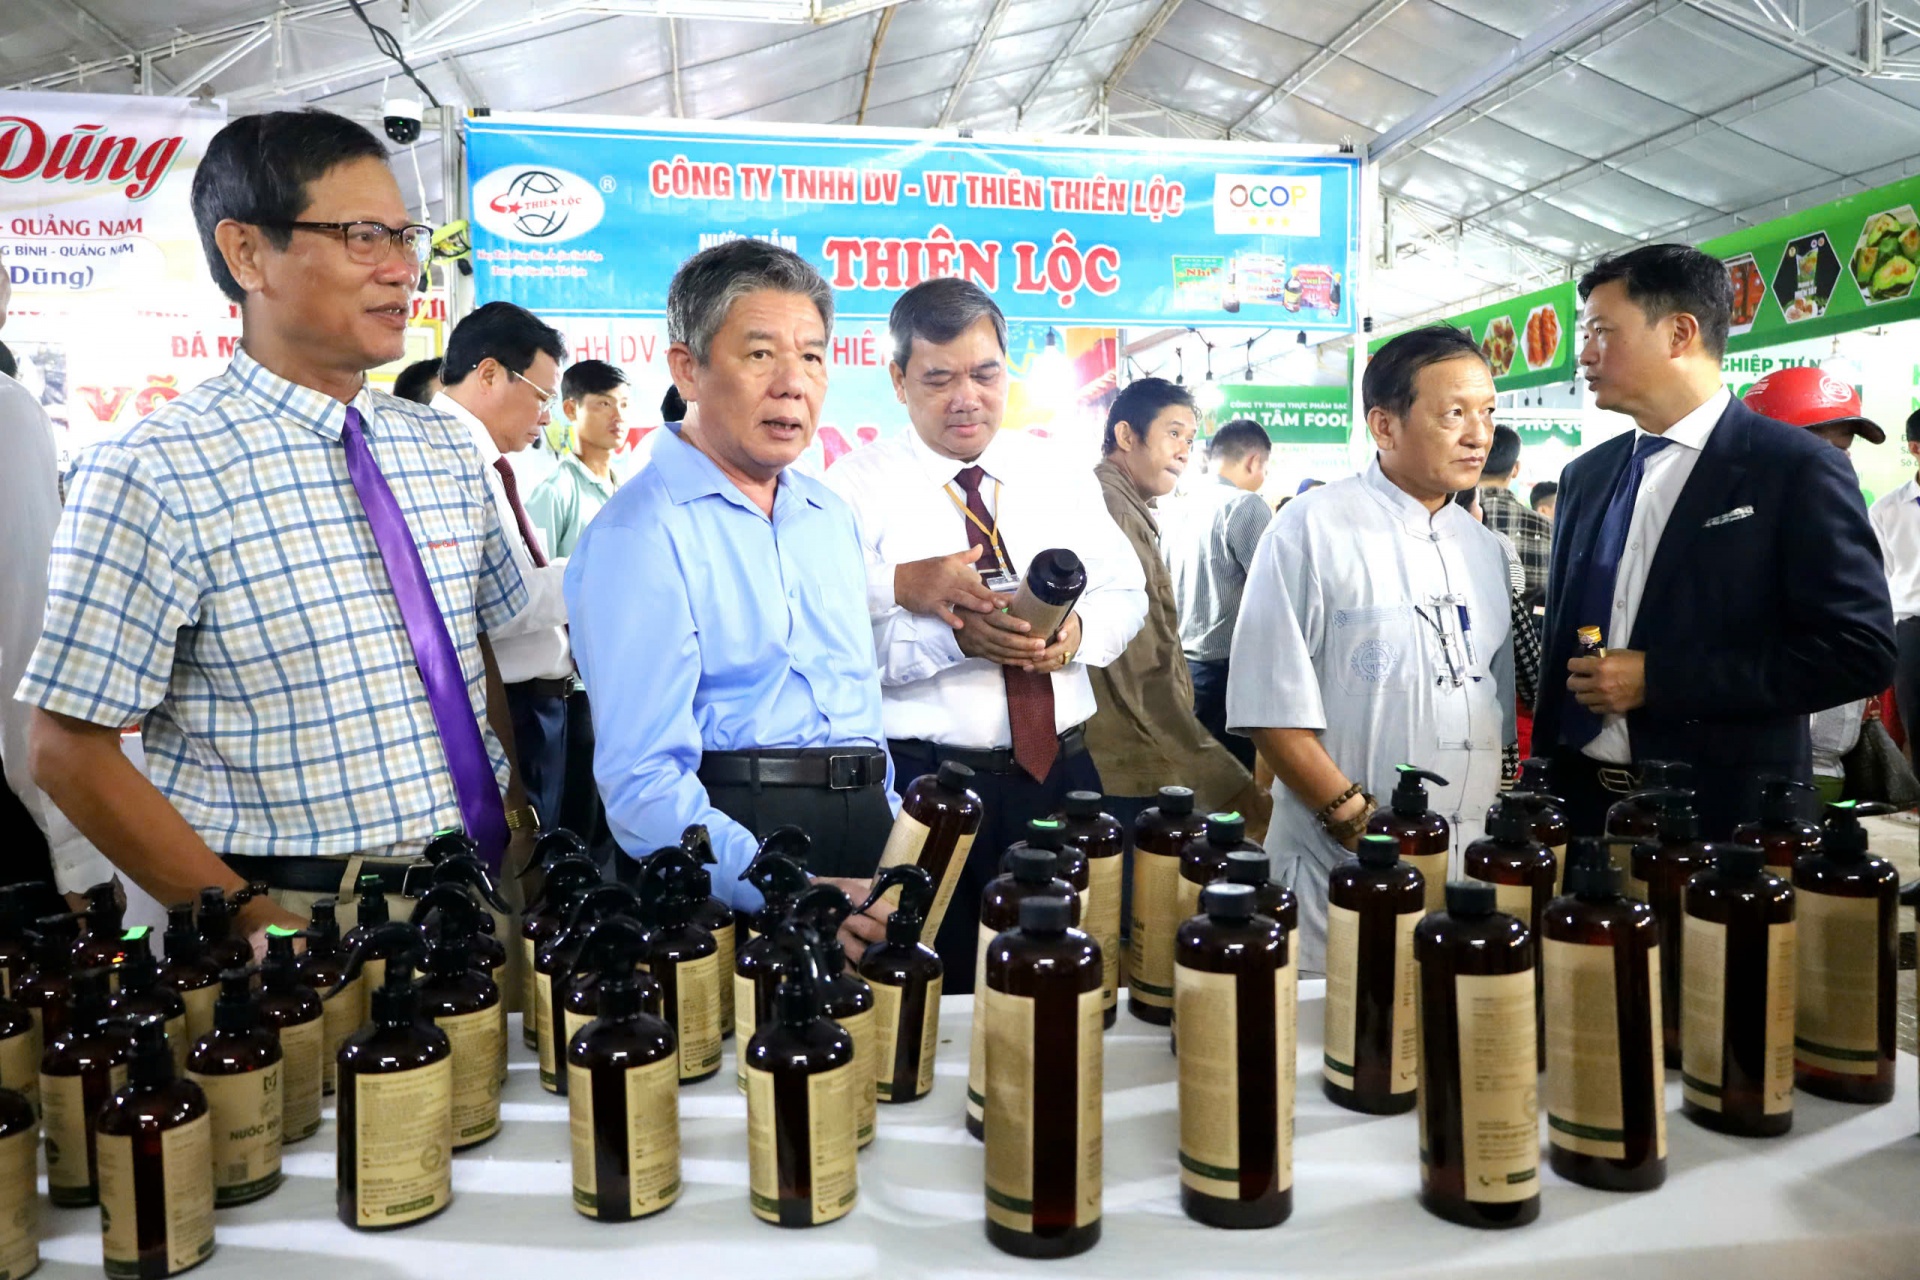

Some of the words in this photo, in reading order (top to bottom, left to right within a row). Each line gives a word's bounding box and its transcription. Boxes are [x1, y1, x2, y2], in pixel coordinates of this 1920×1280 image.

[0, 115, 187, 199] Dũng
[651, 157, 732, 197] CÔNG
[740, 167, 772, 198] TY
[781, 168, 855, 202] TNHH
[864, 171, 898, 202] DV
[926, 173, 957, 203] VT
[965, 172, 1042, 208] THIÊN
[1050, 175, 1126, 212] THIÊN
[1134, 177, 1183, 220] LỘC
[1229, 184, 1307, 207] OCOP
[11, 213, 91, 236] QUẢNG
[99, 217, 143, 236] NAM
[15, 243, 47, 257] BÌNH
[826, 226, 999, 291] THIÊN
[1015, 231, 1118, 306] LỘC
[171, 331, 208, 358] ĐÁ
[621, 335, 656, 363] DV
[1260, 410, 1299, 427] TÂM
